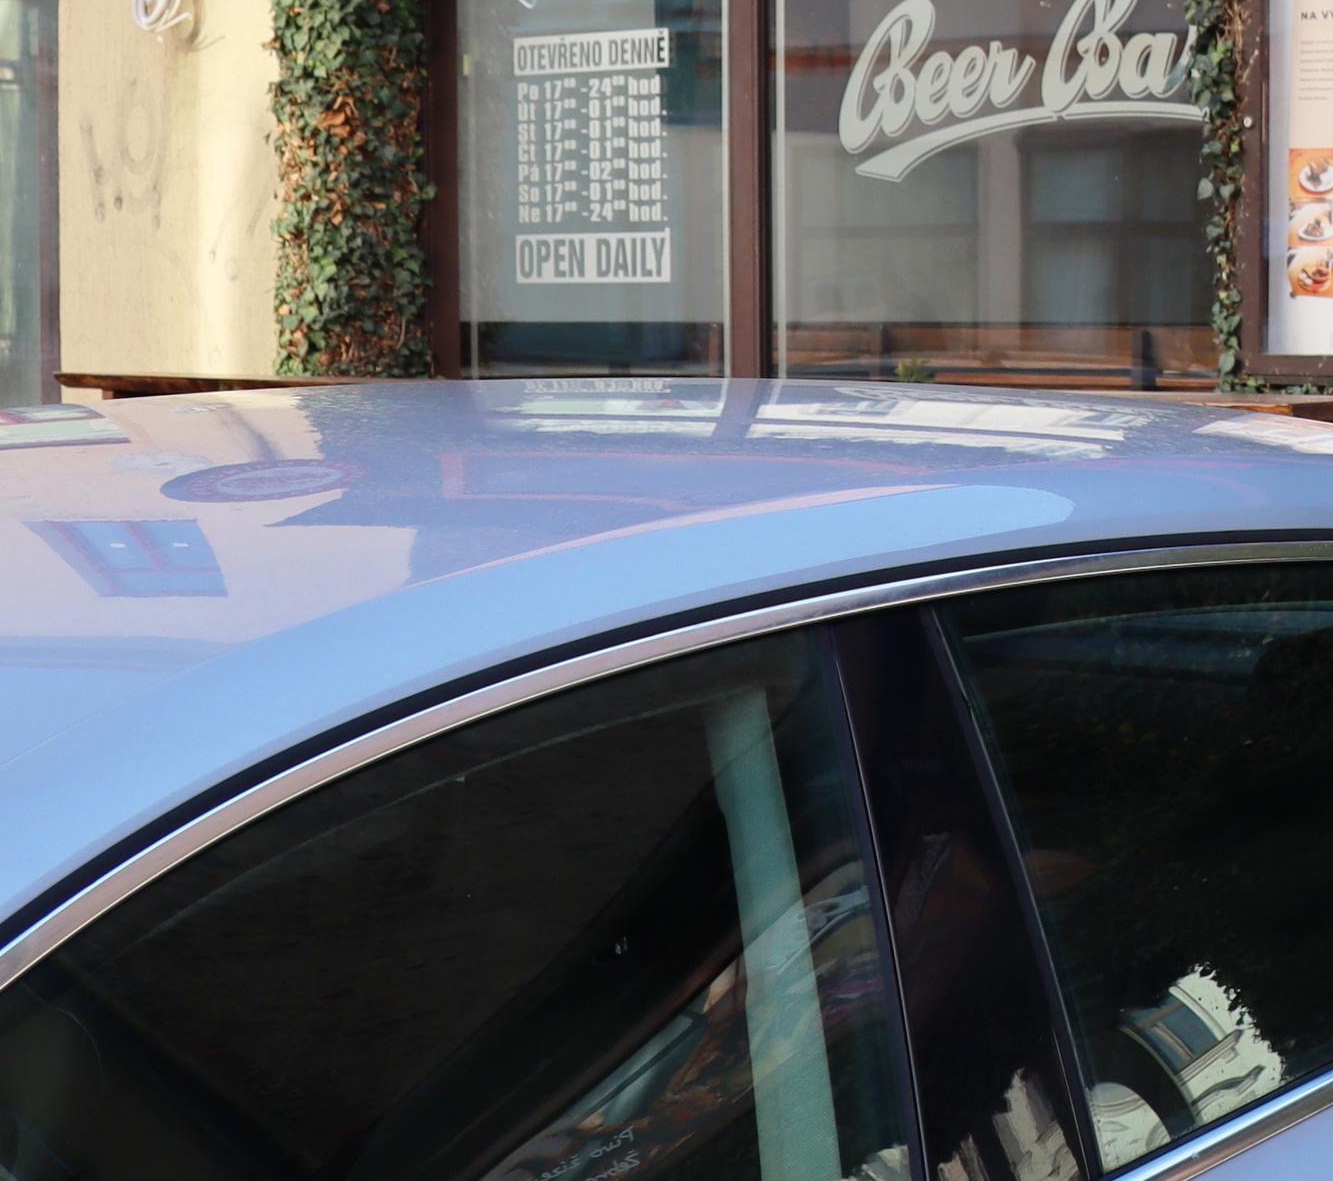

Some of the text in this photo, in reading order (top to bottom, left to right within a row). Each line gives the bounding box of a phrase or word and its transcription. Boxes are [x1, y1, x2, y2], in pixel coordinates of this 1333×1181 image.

[1300, 11, 1317, 20] NA
[518, 30, 665, 72] OTEVŘENO DENNĚ
[519, 237, 666, 279] OPEN DAILY
